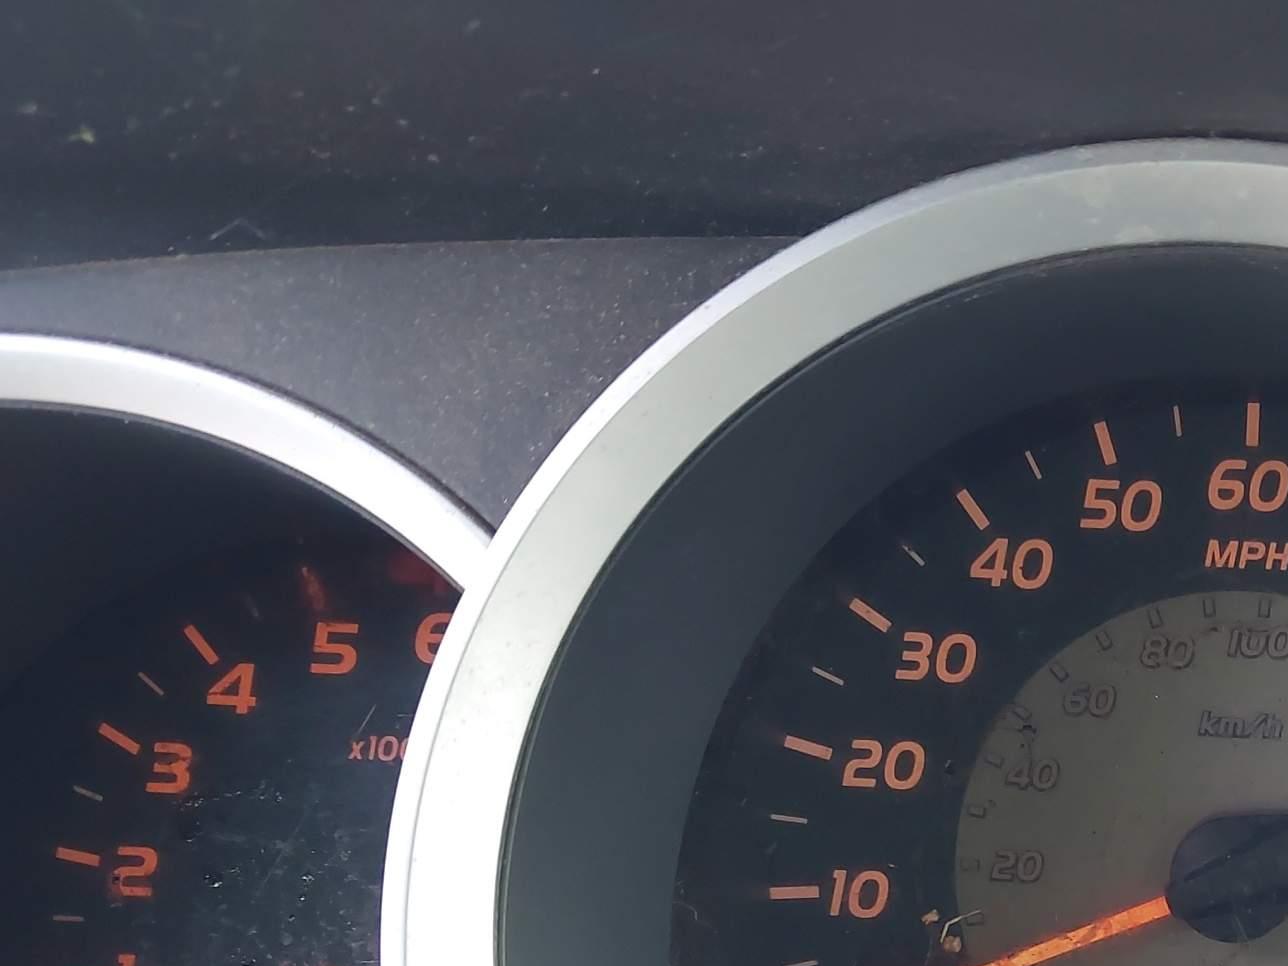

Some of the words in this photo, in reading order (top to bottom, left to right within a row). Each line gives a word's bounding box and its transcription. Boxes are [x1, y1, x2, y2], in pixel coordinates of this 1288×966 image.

[1080, 478, 1162, 532] 50
[970, 538, 1054, 590] 40
[310, 622, 359, 674] 5
[895, 631, 977, 684] 30
[1140, 636, 1196, 670] 80
[206, 663, 257, 715] 4
[1062, 683, 1117, 718] 60
[1198, 711, 1284, 740] km/h
[146, 742, 193, 794] 3
[842, 739, 926, 791] 20
[1005, 757, 1061, 791] 40
[115, 846, 159, 897] 2
[990, 850, 1044, 883] 20
[829, 869, 890, 919] 10
